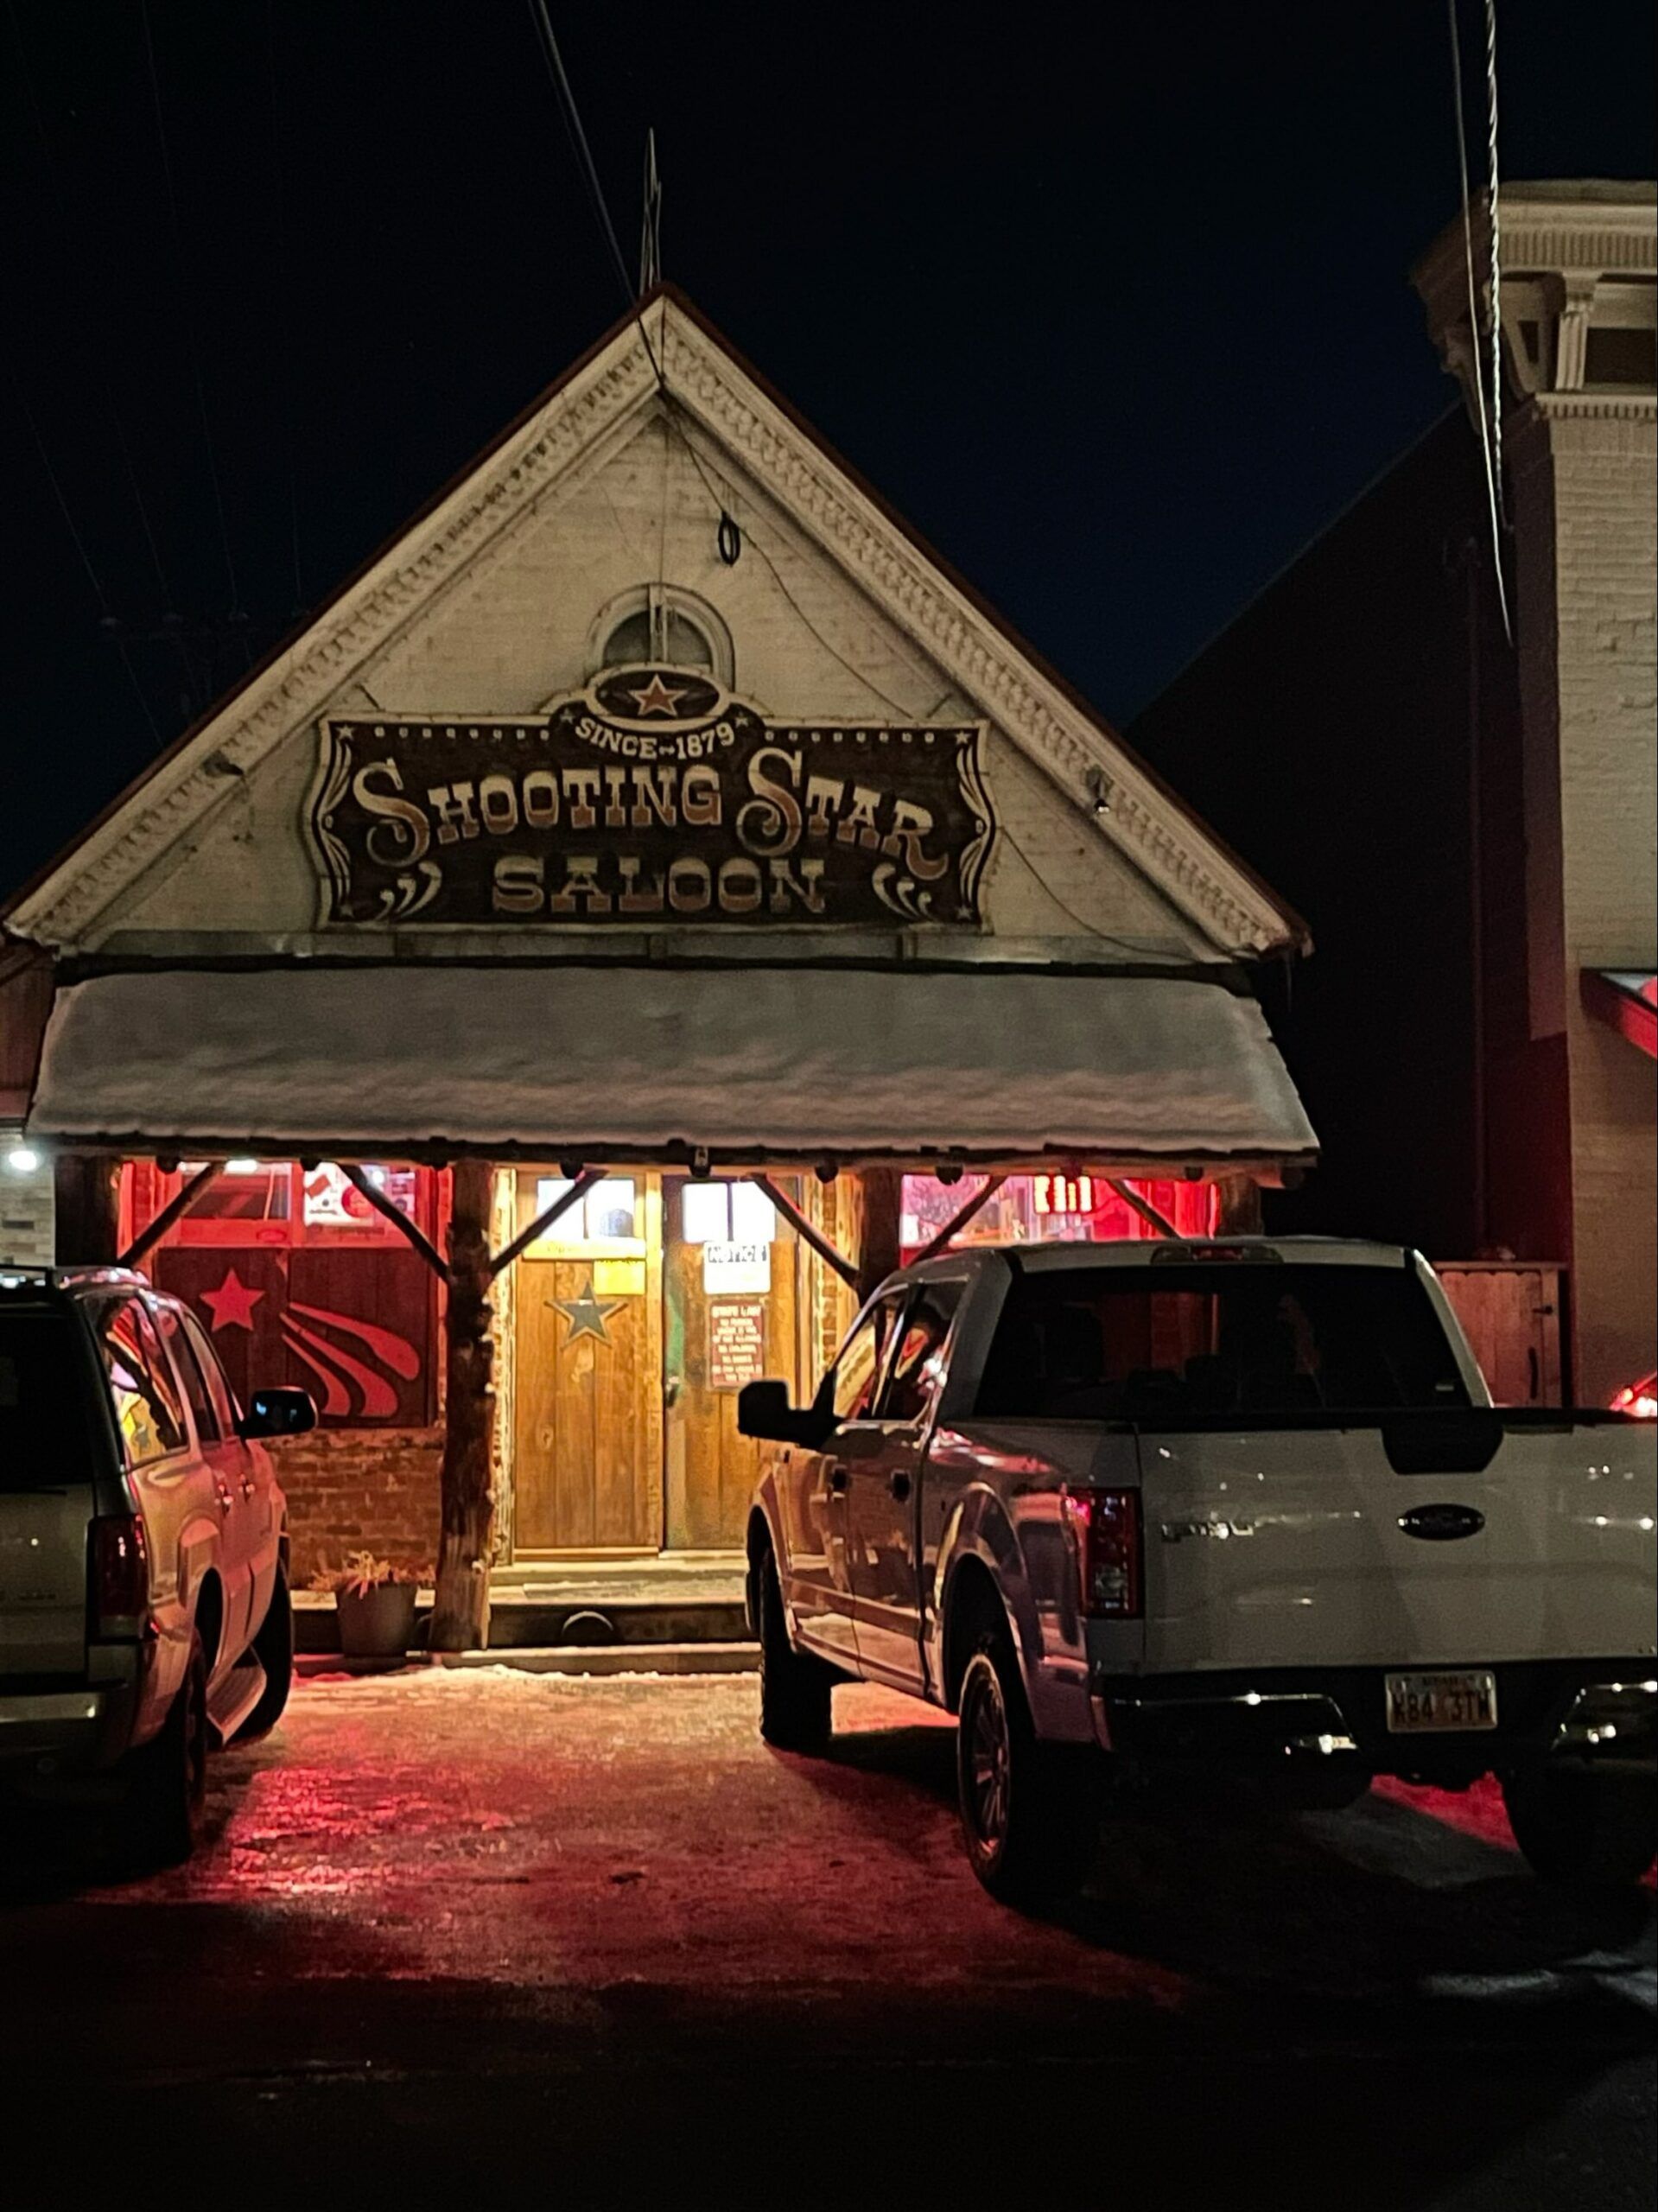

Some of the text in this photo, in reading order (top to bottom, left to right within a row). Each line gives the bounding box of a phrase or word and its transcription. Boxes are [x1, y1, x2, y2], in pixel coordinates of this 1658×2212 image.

[575, 717, 734, 760] SINCE 1879
[353, 747, 950, 879] SHOOTING STAR
[492, 855, 826, 914] SALOON
